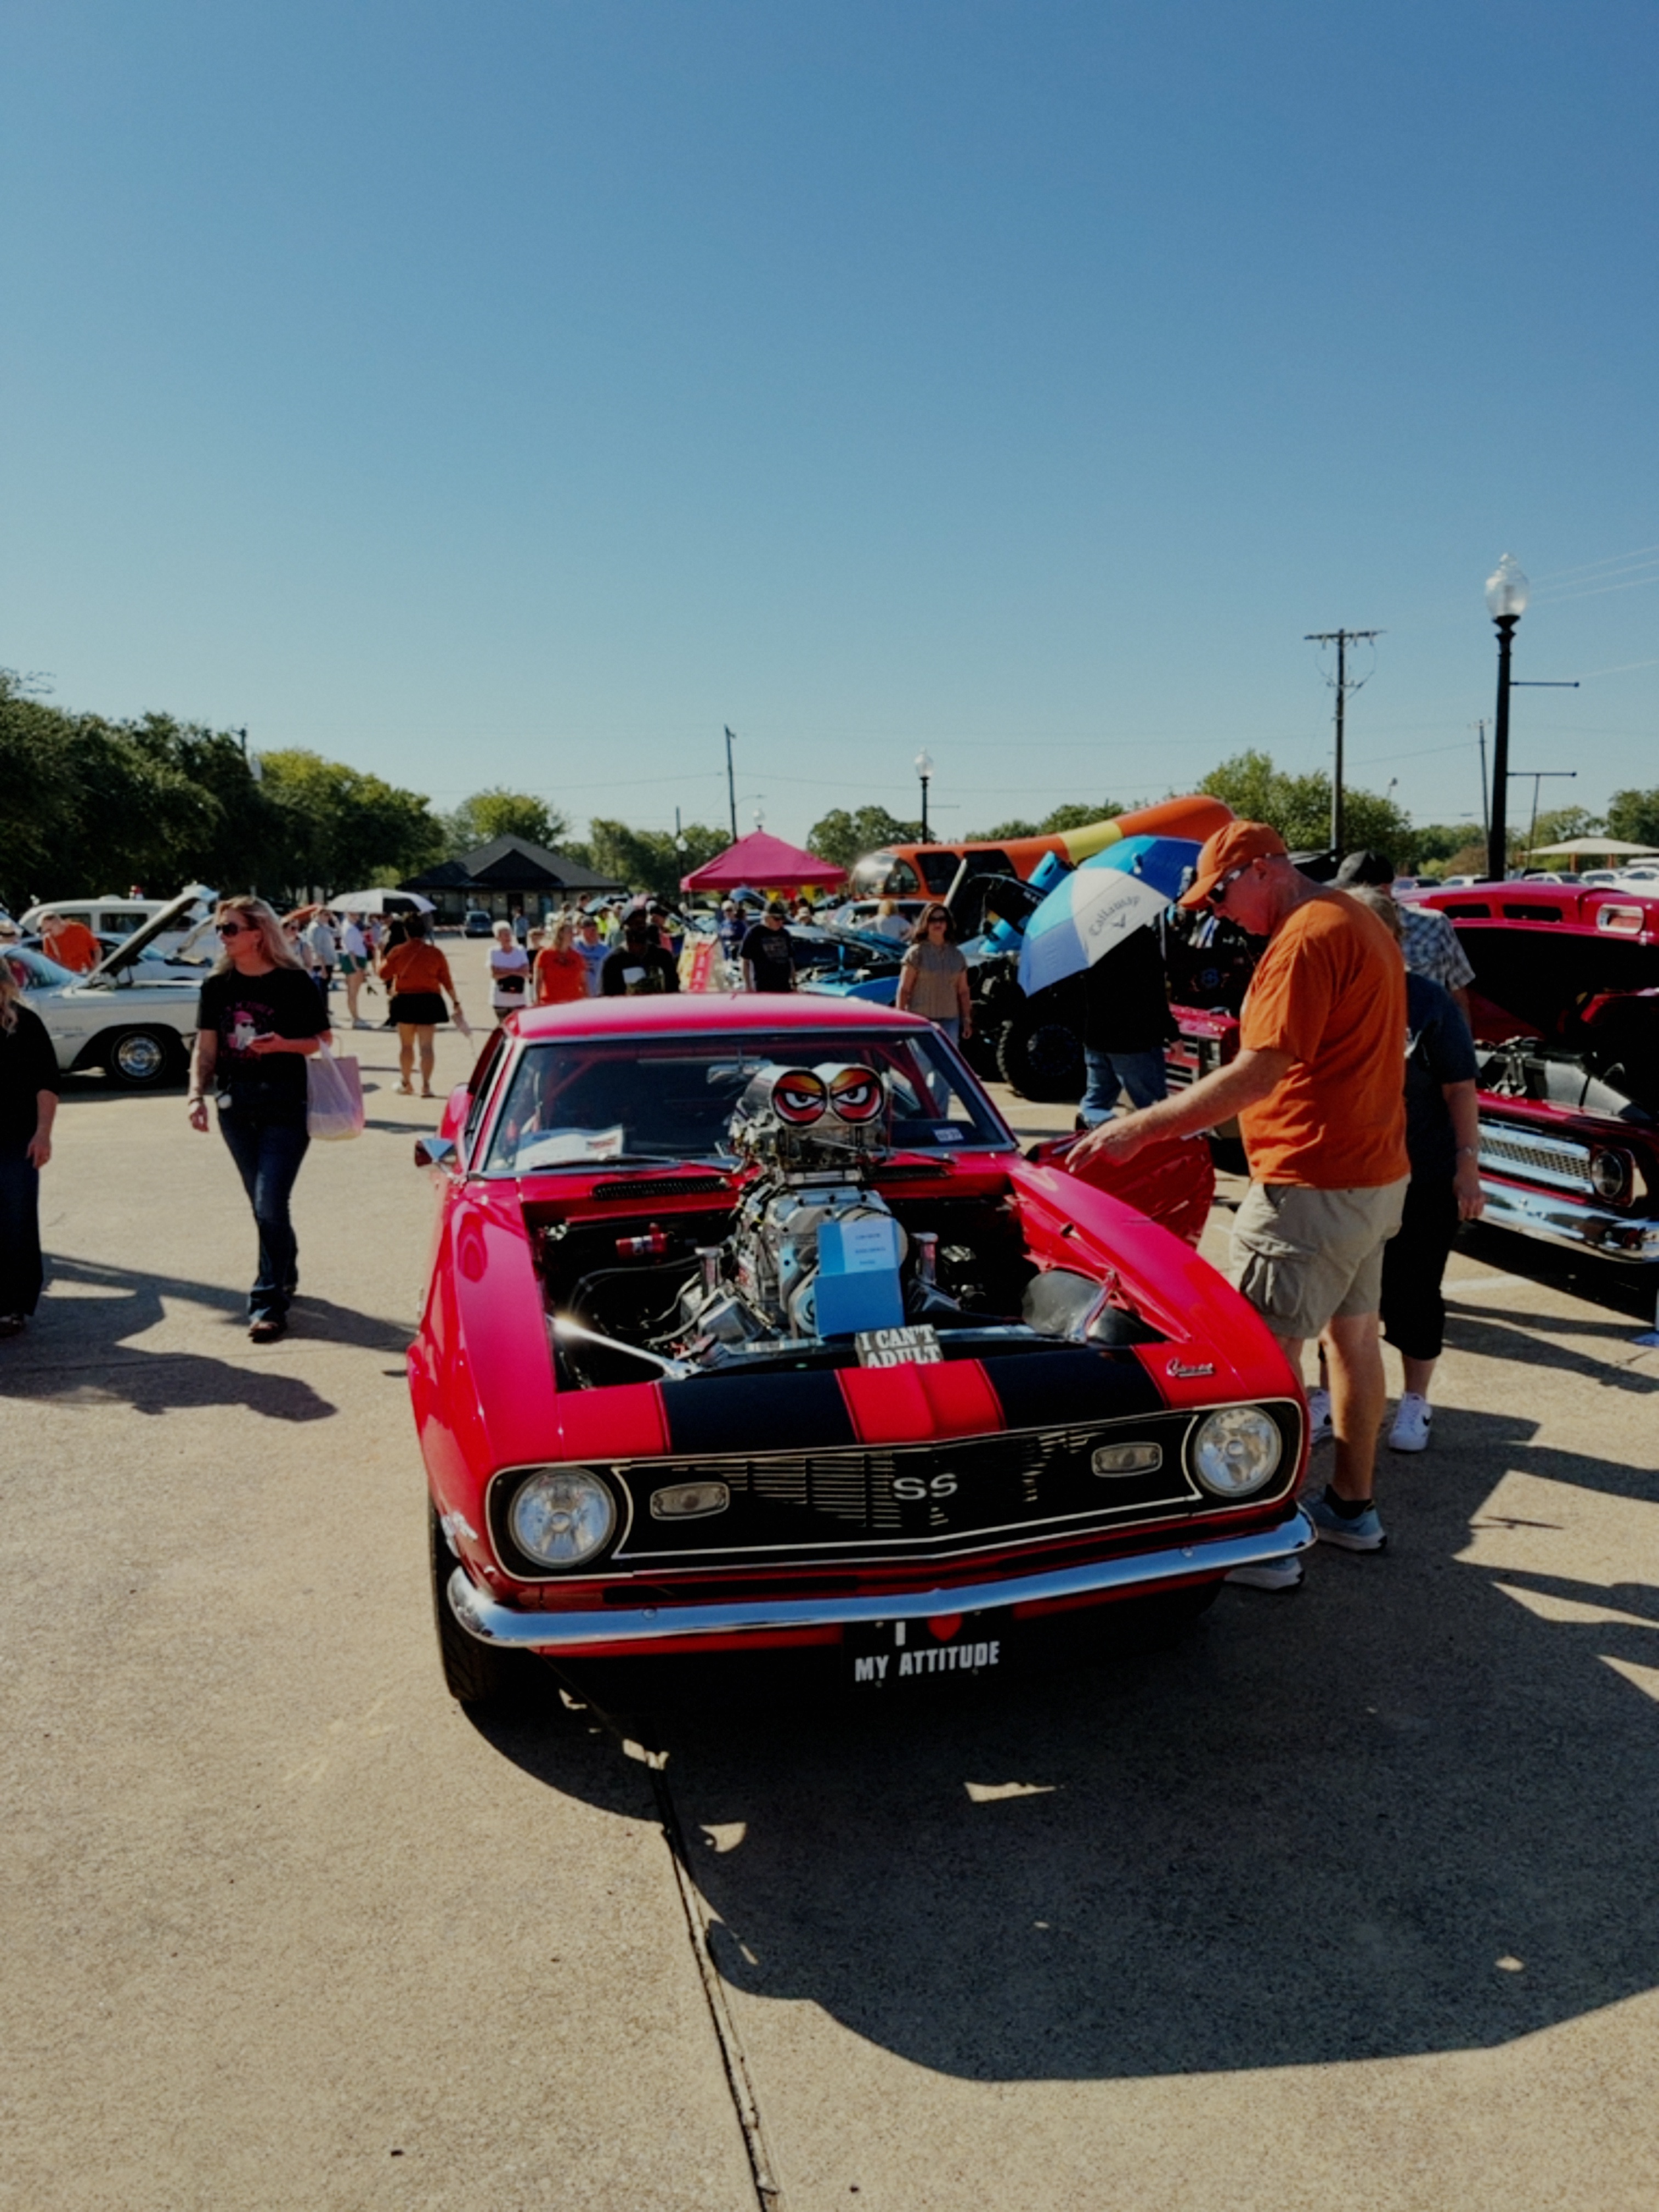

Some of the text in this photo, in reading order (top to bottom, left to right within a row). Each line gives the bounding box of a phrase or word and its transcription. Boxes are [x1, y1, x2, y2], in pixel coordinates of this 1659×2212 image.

[1088, 895, 1141, 936] Callaway
[860, 1323, 934, 1351] I CAN'T
[867, 1345, 941, 1369] ADULT
[893, 1473, 958, 1500] SS
[895, 1621, 905, 1646] I
[855, 1640, 1000, 1682] MY ATTITUDE
